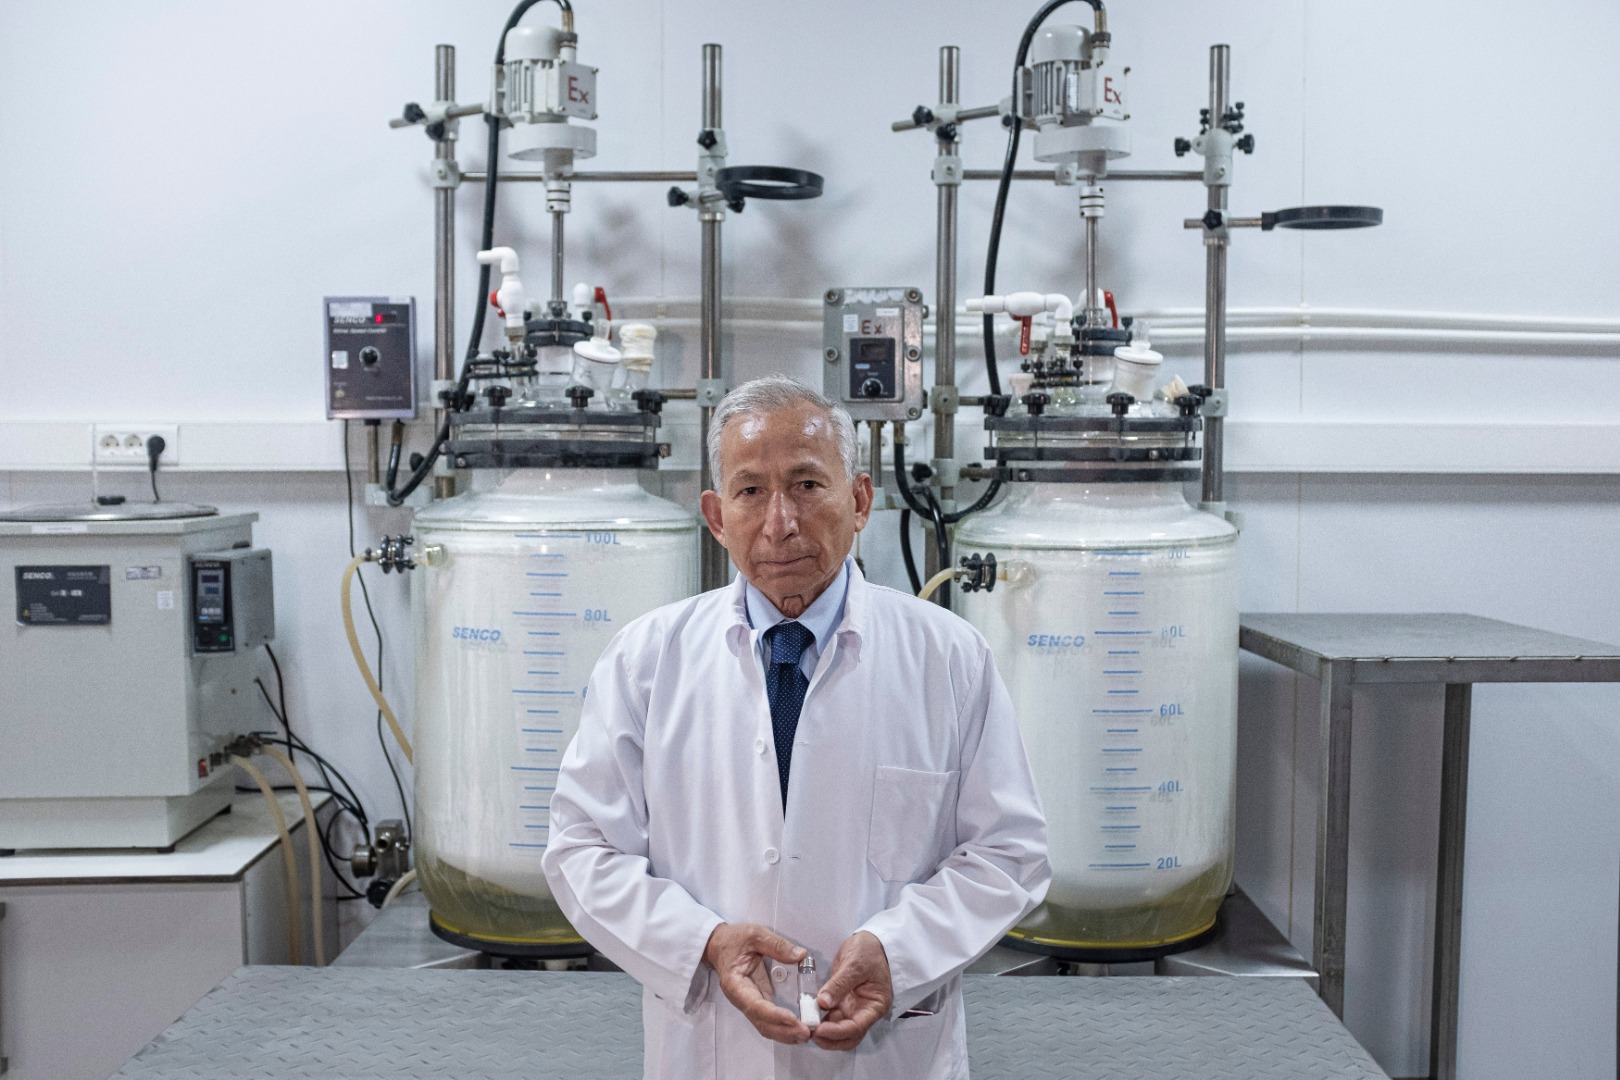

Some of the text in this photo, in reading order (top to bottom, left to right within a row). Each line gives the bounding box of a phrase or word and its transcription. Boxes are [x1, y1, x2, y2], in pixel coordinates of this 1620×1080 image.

[567, 75, 590, 104] Ex
[1104, 77, 1122, 105] Ex
[861, 319, 882, 335] Ex
[585, 532, 620, 544] 100L
[584, 608, 611, 622] 80L
[452, 626, 501, 641] SENCO
[1027, 634, 1085, 647] SENCO
[1160, 703, 1184, 716] 60L
[1158, 780, 1183, 793] 40L
[1157, 856, 1182, 870] 20L
